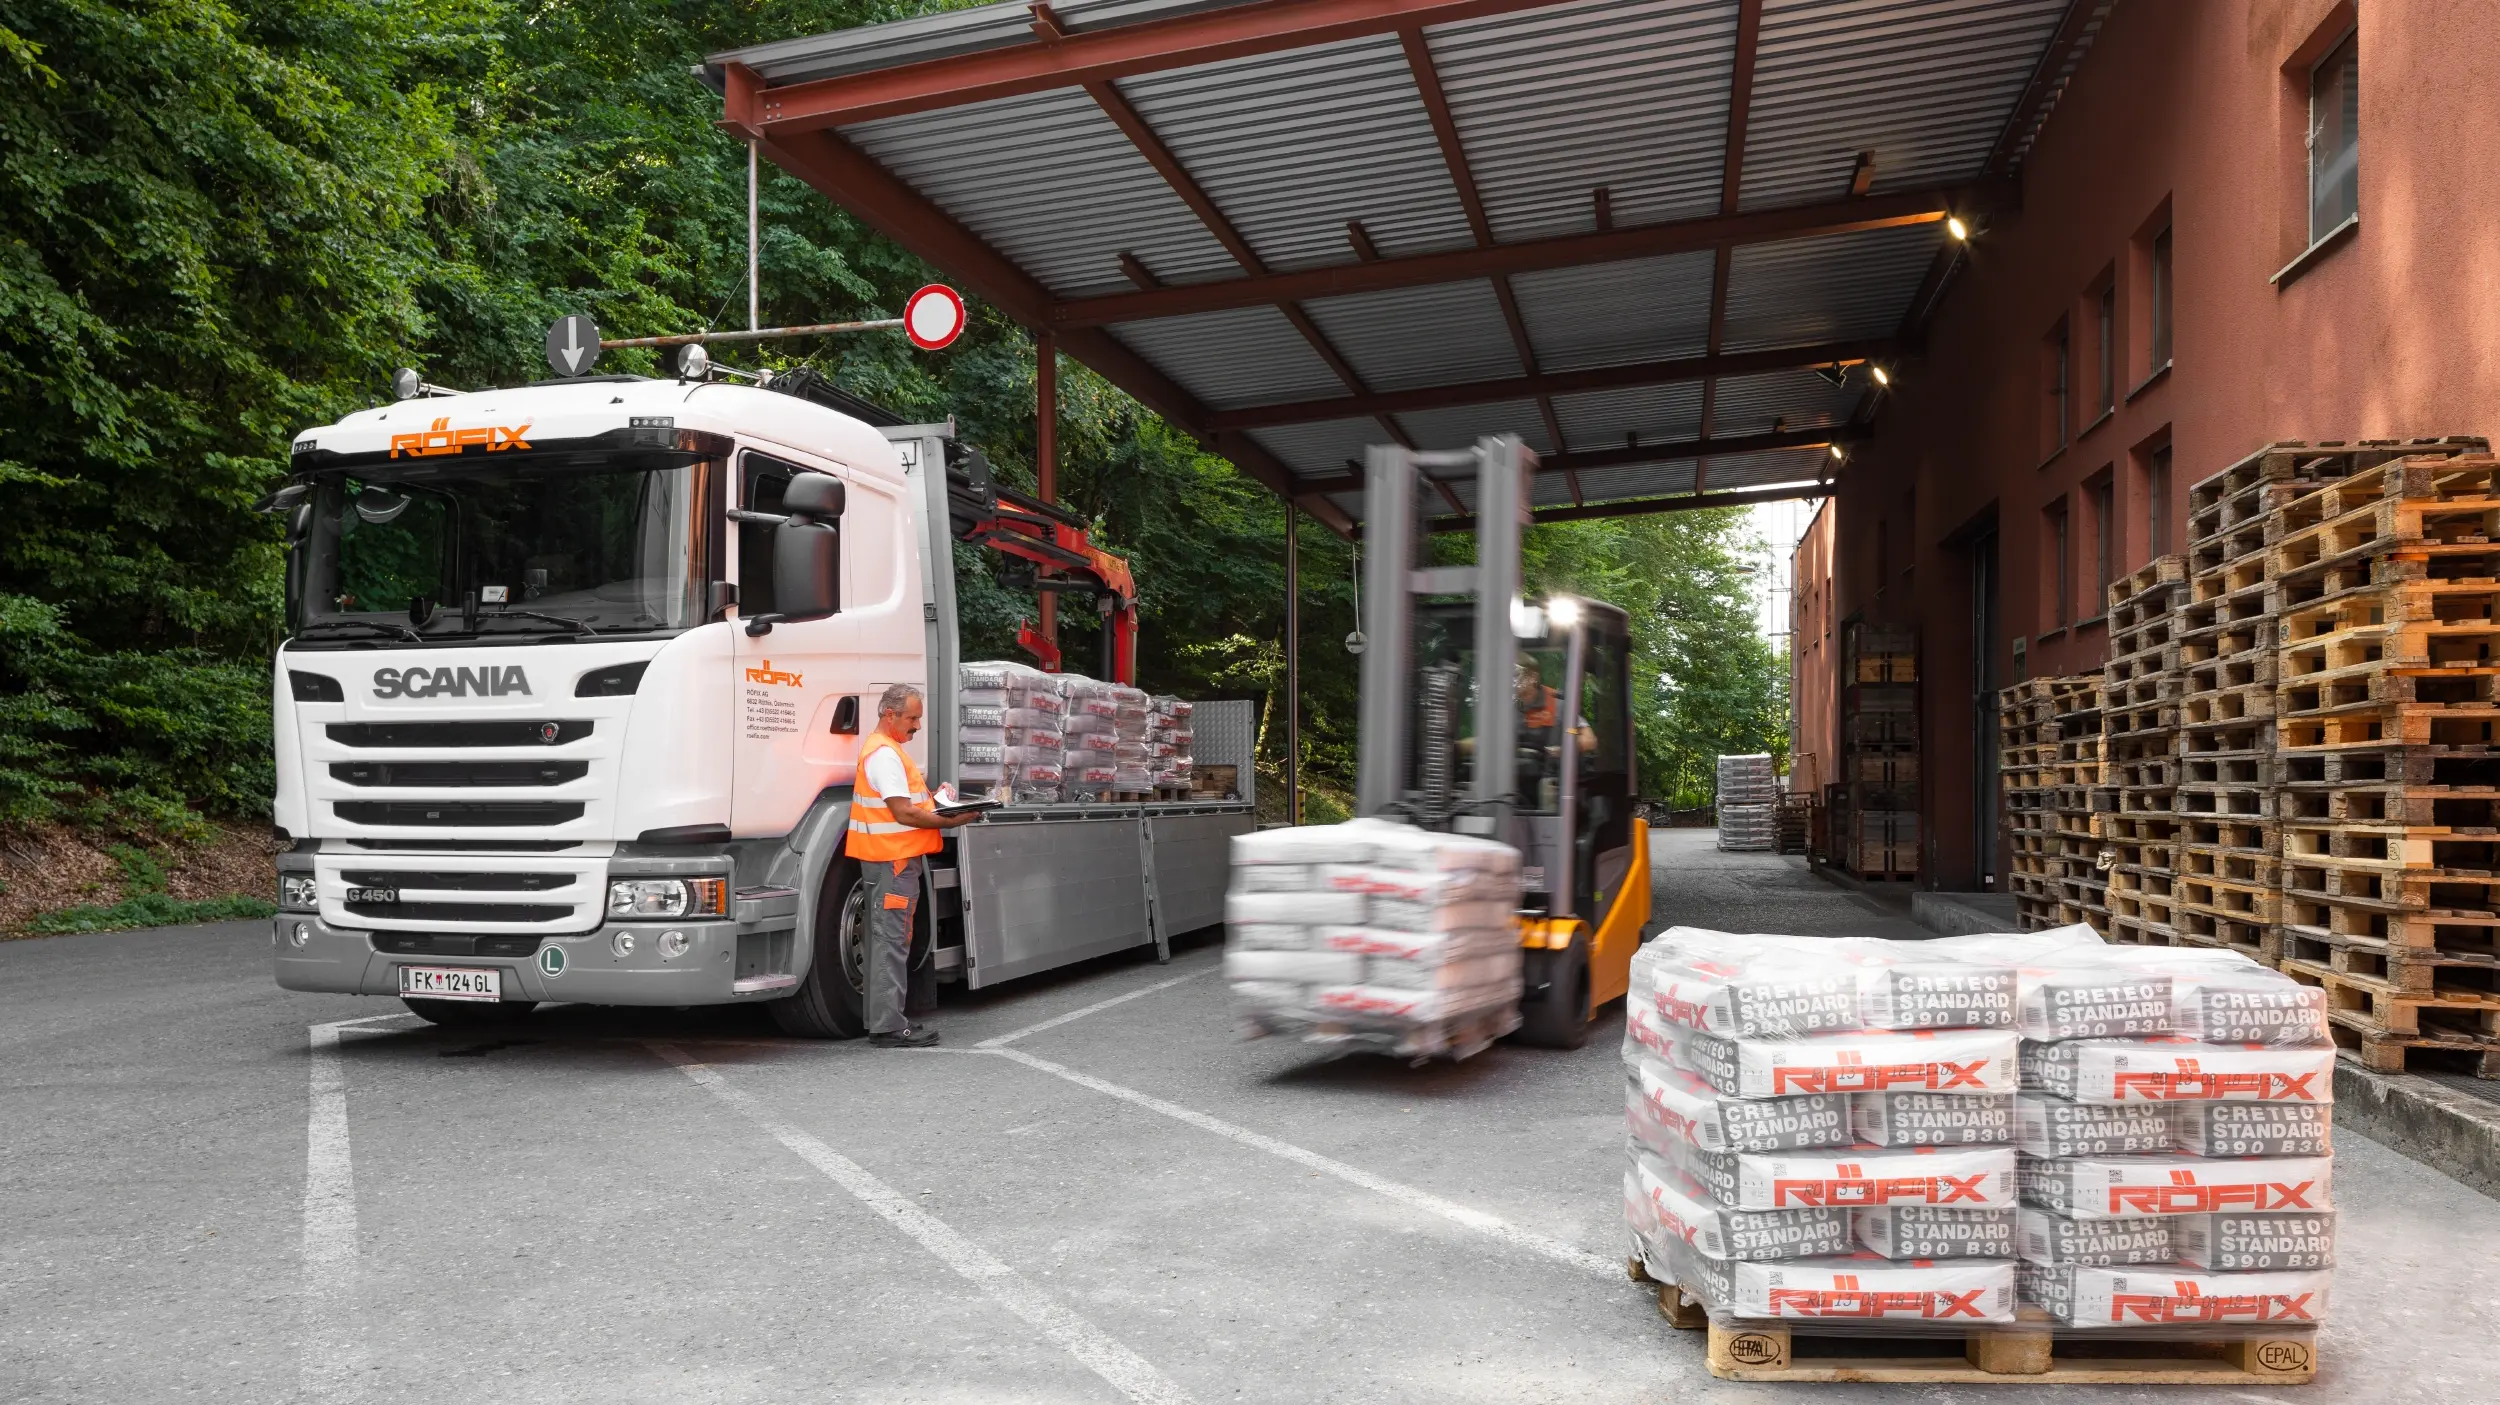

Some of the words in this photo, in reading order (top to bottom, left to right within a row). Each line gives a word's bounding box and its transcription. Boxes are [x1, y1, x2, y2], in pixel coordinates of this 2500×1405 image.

[390, 417, 532, 458] RÖFIX
[745, 660, 803, 687] RÖFIX
[372, 665, 533, 699] SCANIA
[547, 951, 559, 971] L
[415, 972, 433, 990] FK
[445, 973, 470, 991] 124
[475, 975, 492, 992] GL
[1740, 994, 1849, 1020] STANDARD
[1900, 993, 2009, 1009] STANDARD
[1901, 1012, 1949, 1025] 990
[1966, 1010, 2011, 1024] B30
[2057, 1001, 2165, 1022] STANDARD
[2212, 1009, 2320, 1025] STANDARD
[1808, 1012, 1853, 1028] B30
[2059, 1023, 2107, 1037] 990
[2213, 1028, 2261, 1040] 990
[1773, 1050, 1990, 1095] RÖFIX
[1839, 1066, 1856, 1079] 13
[2113, 1058, 2318, 1100] RÖFIX
[1728, 1111, 1838, 1139] STANDARD
[1895, 1111, 2005, 1127] STANDARD
[1796, 1128, 1841, 1146] B30
[1896, 1130, 1945, 1143] 990
[1962, 1128, 2007, 1142] B30
[2056, 1118, 2165, 1140] STANDARD
[2213, 1122, 2324, 1138] STANDARD
[2059, 1141, 2107, 1155] 990
[2124, 1135, 2168, 1150] B30
[2214, 1140, 2264, 1154] 990
[2281, 1140, 2324, 1152] B30
[1774, 1163, 1989, 1207] RÖFIX
[1832, 1183, 1848, 1196] 13
[2109, 1170, 2315, 1214] RÖFIX
[1733, 1221, 1840, 1248] STANDARD
[1900, 1223, 2009, 1239] STANDARD
[1800, 1239, 1843, 1255] B30
[1901, 1241, 1949, 1255] 990
[1966, 1241, 2010, 1255] B30
[2061, 1230, 2168, 1253] STANDARD
[2221, 1236, 2330, 1252] STANDARD
[2128, 1247, 2170, 1263] B30
[2221, 1254, 2270, 1267] 990
[2287, 1254, 2331, 1267] B30
[1769, 1275, 1986, 1318] RÖFIX
[1834, 1294, 1852, 1306] 13
[2111, 1280, 2315, 1322] RÖFIX
[2266, 1347, 2301, 1363] EPAL
